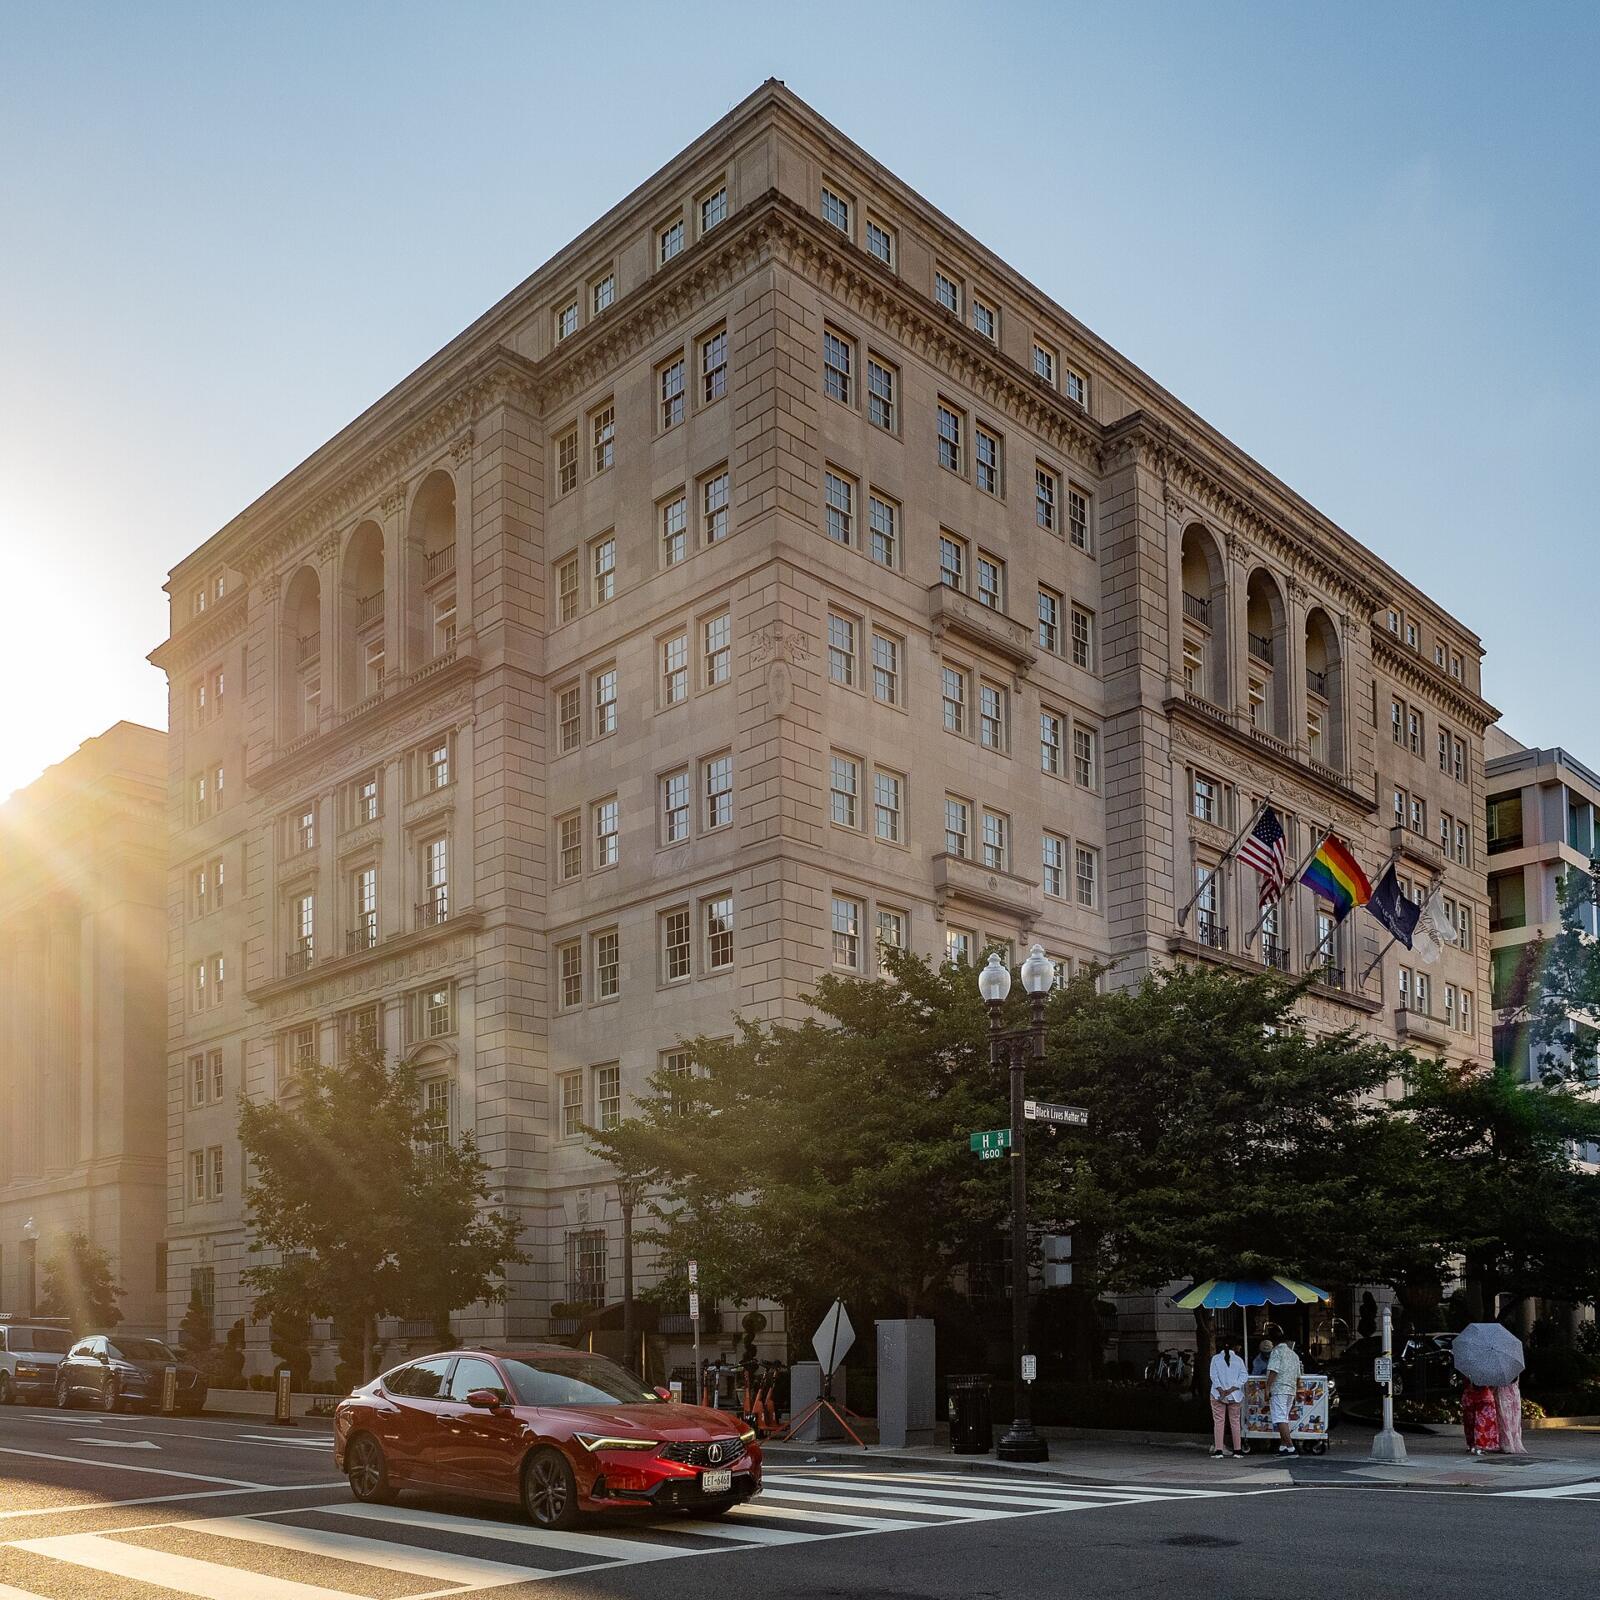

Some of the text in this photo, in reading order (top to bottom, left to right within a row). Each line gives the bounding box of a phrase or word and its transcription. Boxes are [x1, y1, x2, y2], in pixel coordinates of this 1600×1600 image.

[1036, 1106, 1050, 1118] Black
[1050, 1108, 1064, 1120] Lives
[1064, 1110, 1080, 1123] Matter
[982, 1134, 989, 1148] H
[982, 1149, 1000, 1159] 1600
